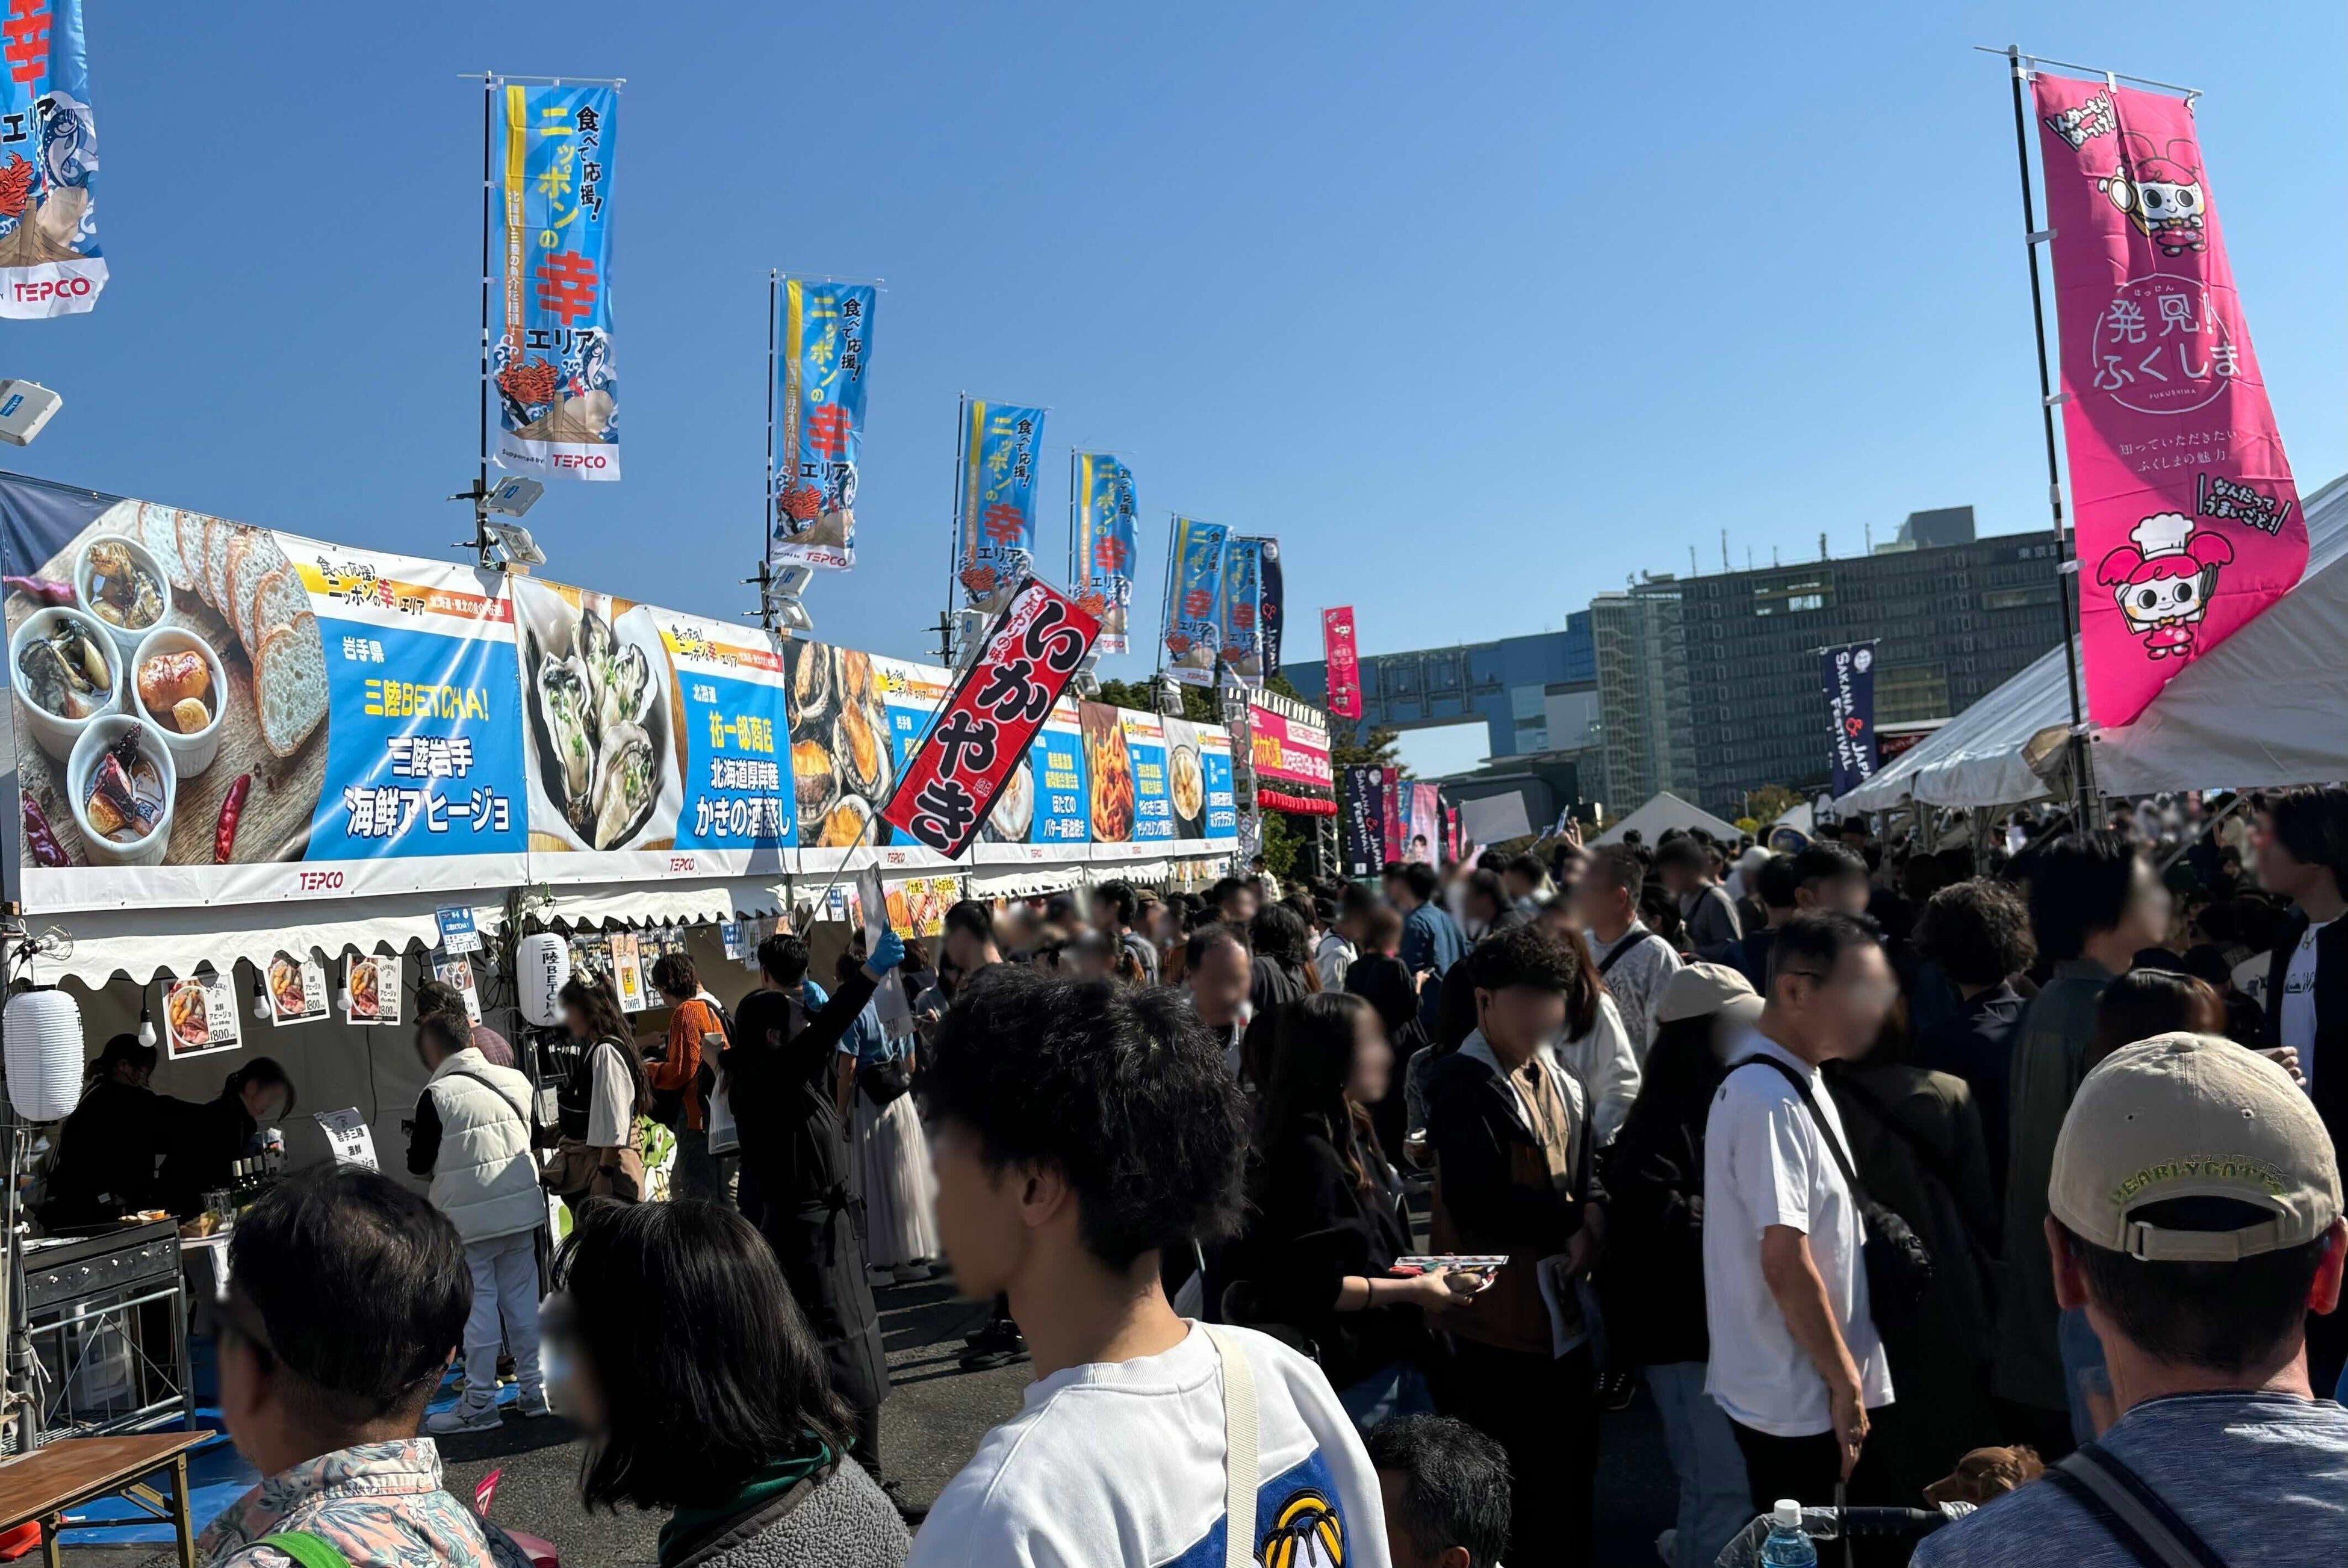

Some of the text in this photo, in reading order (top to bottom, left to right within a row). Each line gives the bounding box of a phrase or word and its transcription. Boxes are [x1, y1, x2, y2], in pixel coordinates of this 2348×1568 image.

[576, 105, 602, 221] 食べて応援！
[14, 277, 90, 302] TEPCO
[2134, 284, 2175, 297] はっけん
[526, 329, 594, 355] エリア
[840, 297, 862, 382] 食べて応援！
[2093, 340, 2242, 391] ふくしま
[2149, 388, 2197, 400] FUKUSHIMA
[552, 454, 607, 469] TEPCO
[800, 462, 849, 482] エリア
[2214, 477, 2275, 510] なんだって
[806, 551, 847, 567] TEPCO
[978, 547, 1023, 563] エリア
[316, 556, 376, 582] 食べて応援！
[1091, 575, 1125, 589] エリア
[343, 636, 385, 663] 岩手県
[364, 679, 489, 721] 三陸BETCHA!
[910, 598, 1086, 851] いかやき
[1836, 651, 1872, 781] SAKANA & JAPA
[1830, 696, 1853, 772] FESTIVAL
[387, 736, 474, 778] 三陸岩手
[710, 756, 780, 790] 北海道厚岸産
[343, 785, 509, 838] 海鮮アヒージョ
[694, 795, 790, 838] かきの酒蒸し
[1355, 769, 1384, 872] SAKANA & JAPAN
[1352, 801, 1370, 854] FESTIVAL
[669, 858, 695, 872] TEPCO
[887, 852, 905, 863] TEPCO
[299, 871, 344, 890] TEPCO
[624, 998, 641, 1009] 700円
[210, 1028, 229, 1041] 1800
